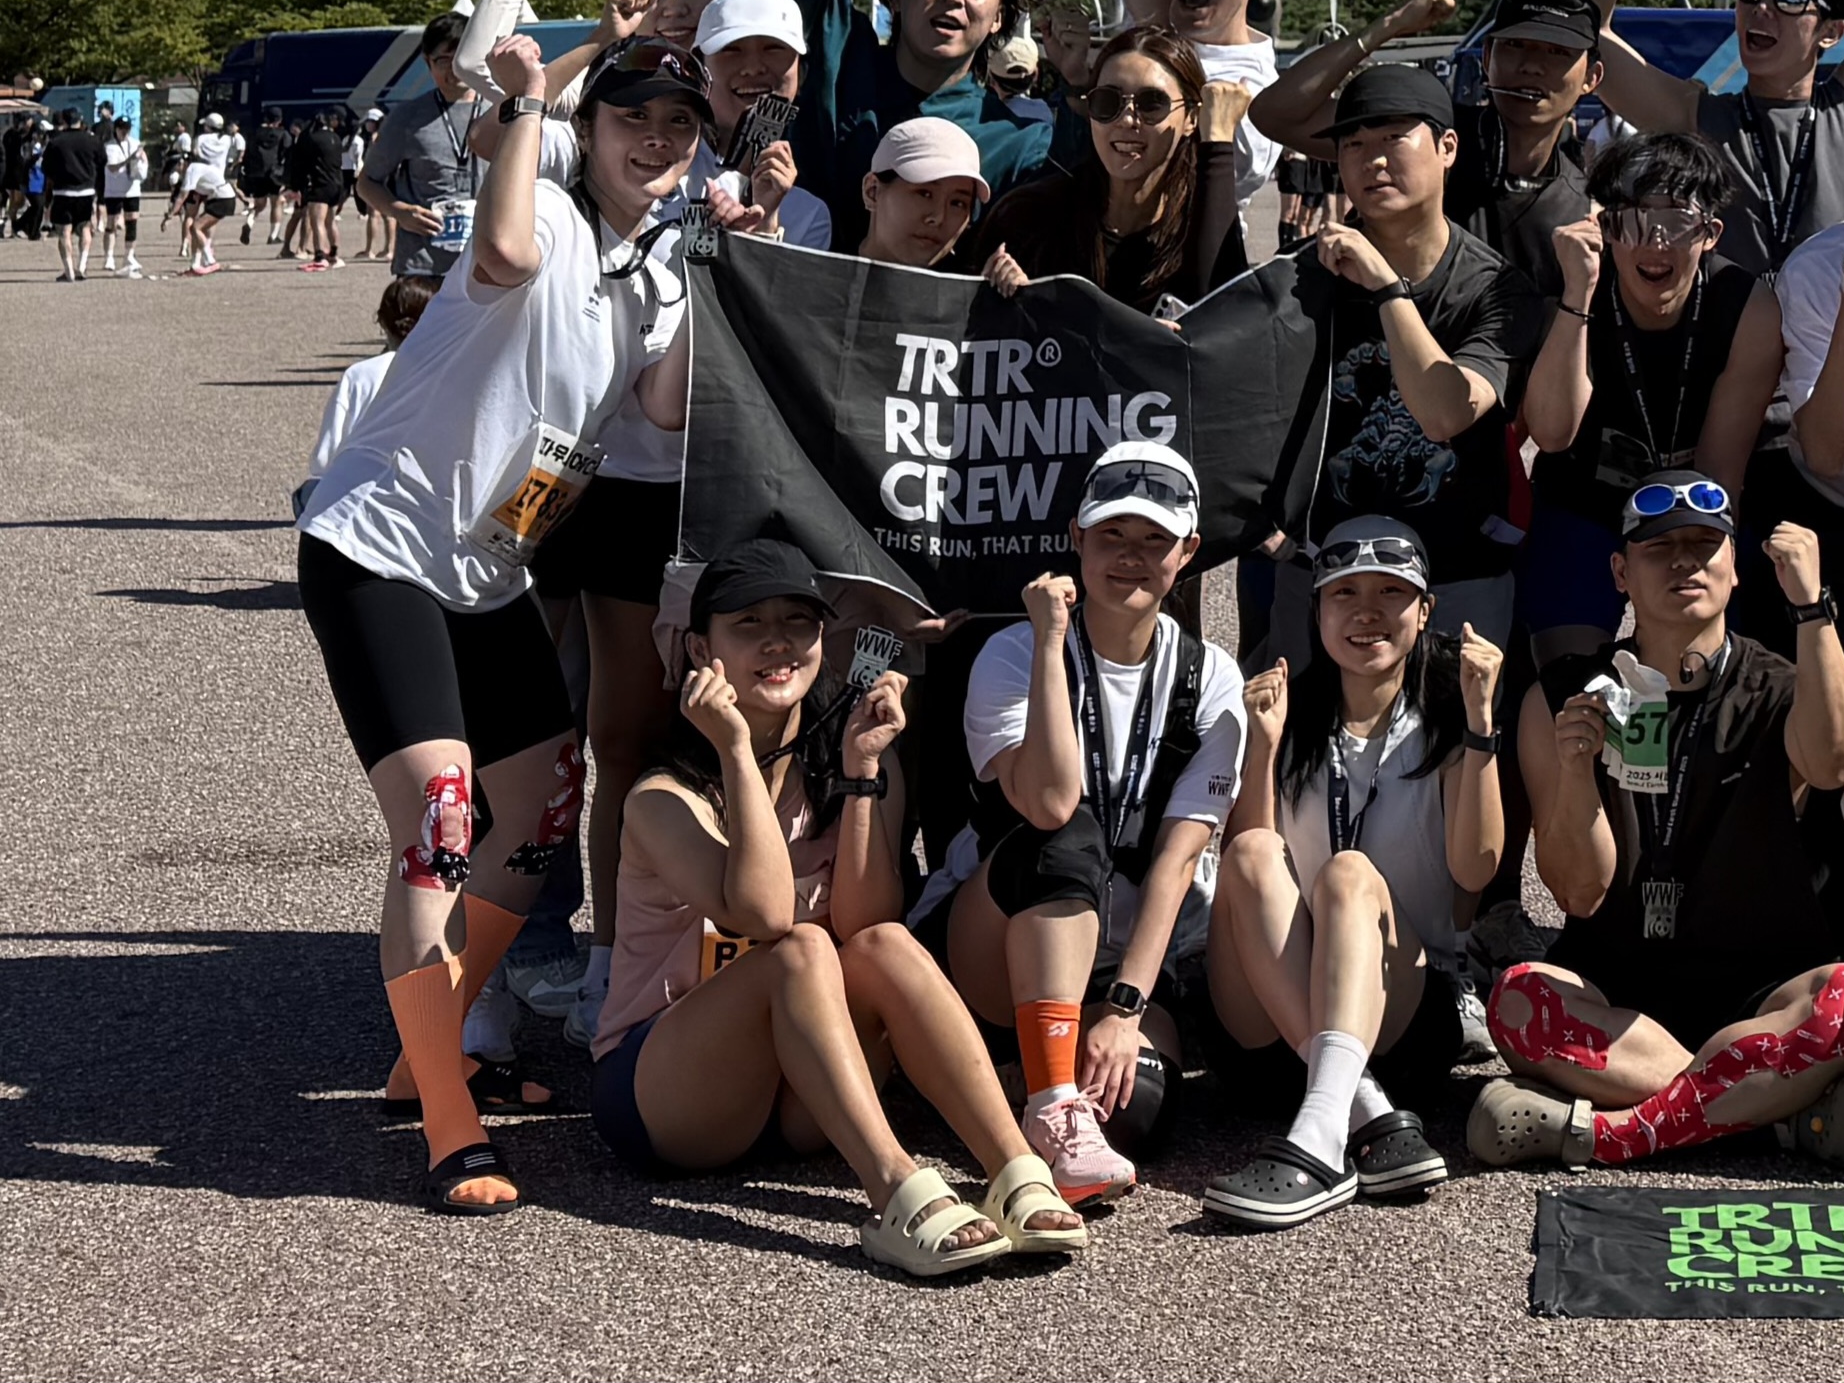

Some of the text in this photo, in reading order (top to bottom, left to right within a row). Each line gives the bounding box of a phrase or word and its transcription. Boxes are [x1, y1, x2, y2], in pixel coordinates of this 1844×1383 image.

[884, 391, 1178, 461] RUNNING
[880, 461, 1063, 525] CREW
[874, 527, 1080, 561] THIS RUN, THAT RU
[856, 627, 904, 662] WWF
[1625, 712, 1668, 745] 57
[1627, 770, 1651, 780] 2025
[1642, 882, 1685, 907] WWF
[1664, 1277, 1737, 1294] THIS
